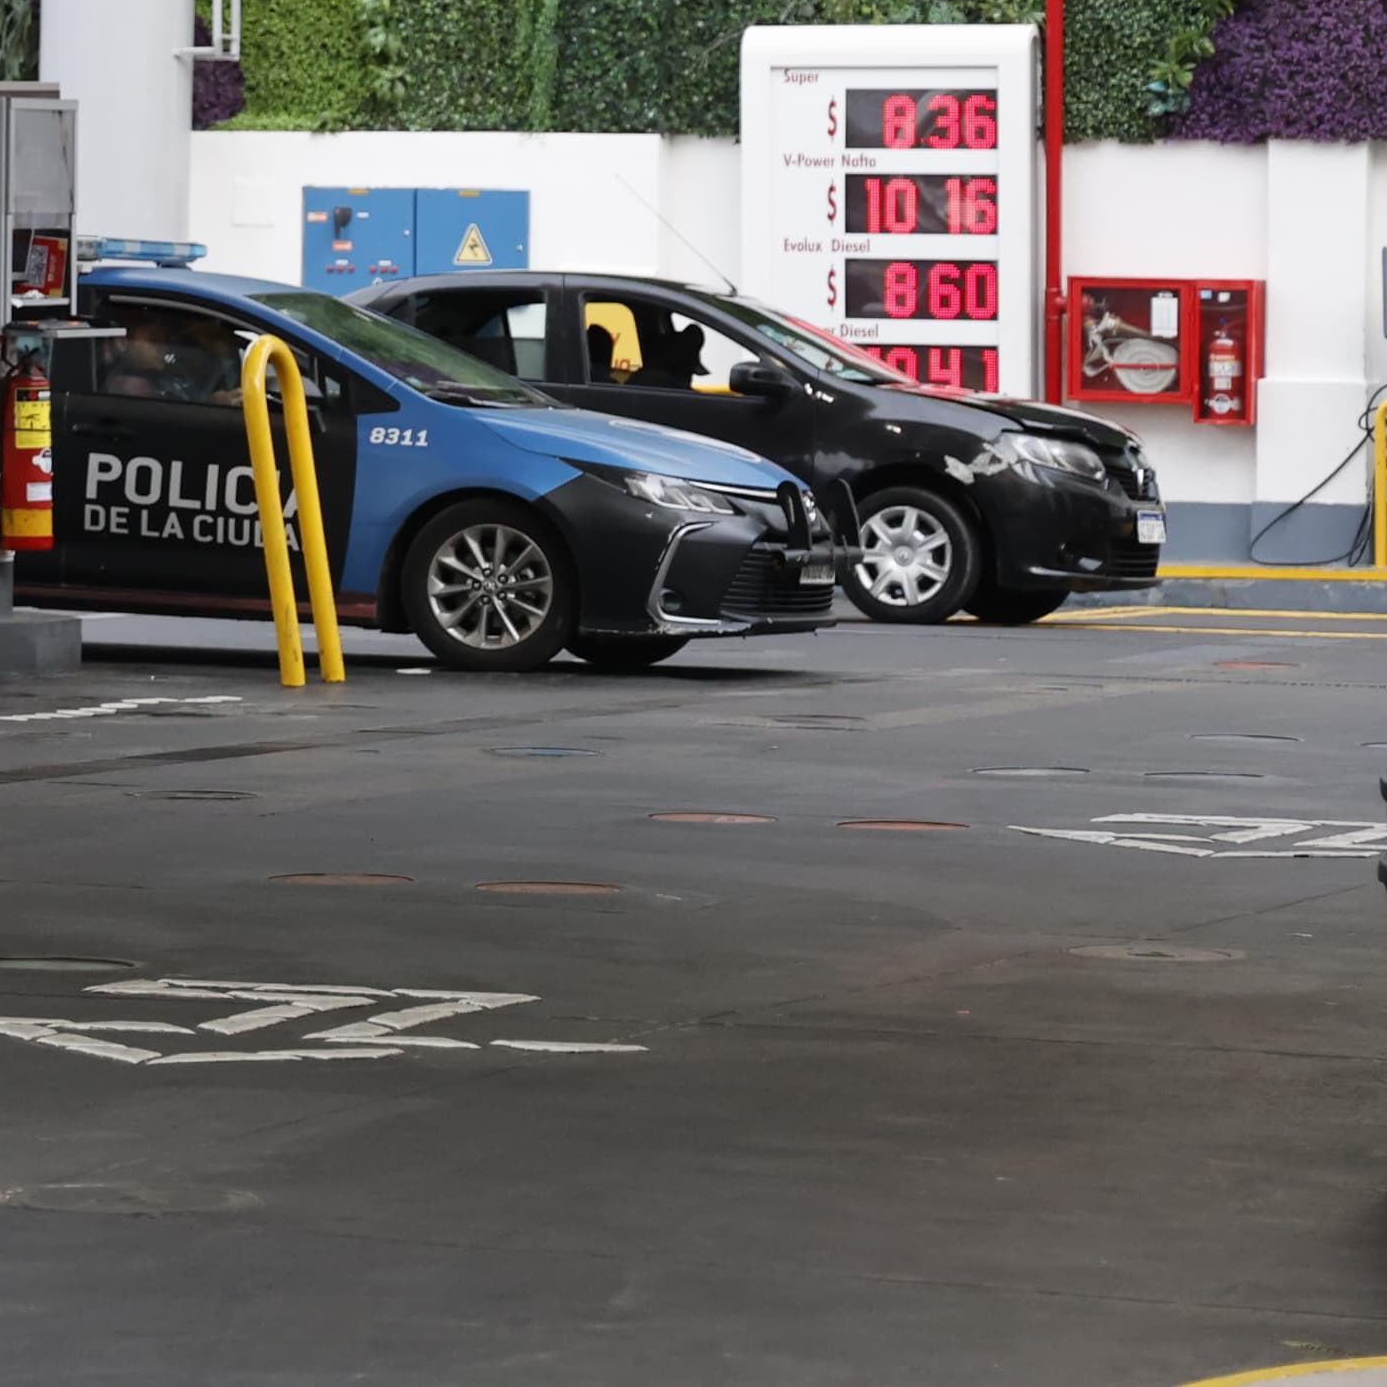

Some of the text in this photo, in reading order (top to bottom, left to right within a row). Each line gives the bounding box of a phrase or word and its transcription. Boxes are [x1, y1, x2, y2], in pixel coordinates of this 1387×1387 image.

[783, 68, 819, 84] Super
[783, 153, 876, 168] V-Power Nafta
[783, 238, 870, 253] Evolux Diesel
[840, 323, 879, 338] Diesel
[370, 427, 429, 447] 8311
[84, 504, 130, 535] DE
[140, 509, 184, 539] LA
